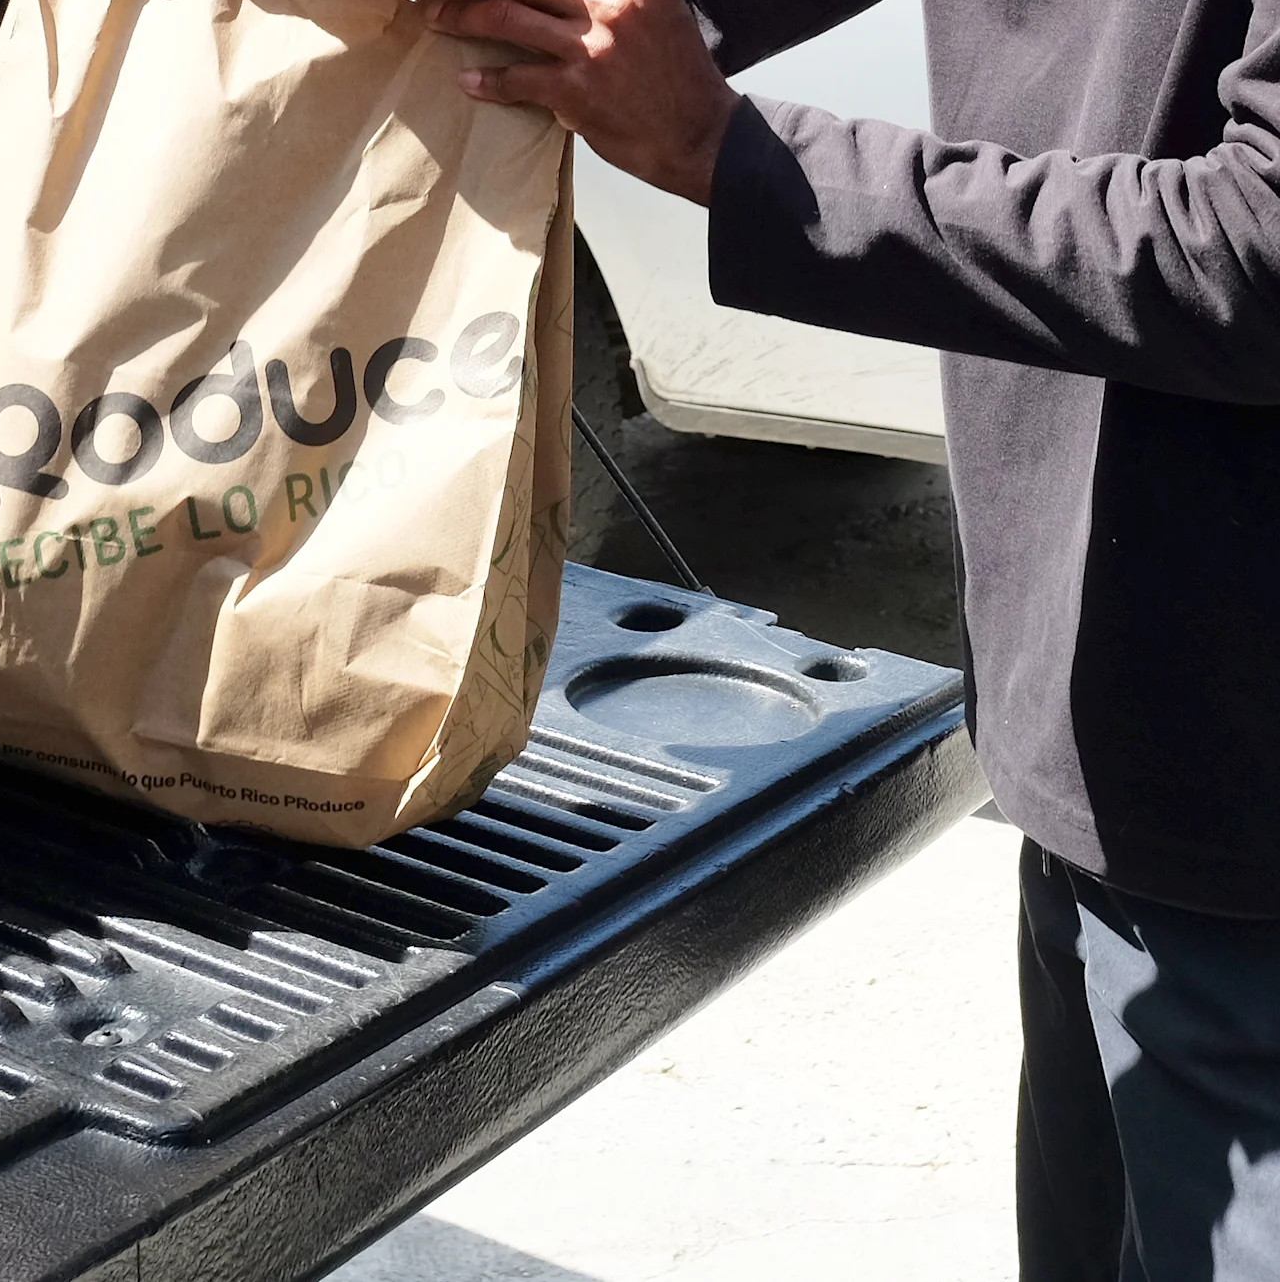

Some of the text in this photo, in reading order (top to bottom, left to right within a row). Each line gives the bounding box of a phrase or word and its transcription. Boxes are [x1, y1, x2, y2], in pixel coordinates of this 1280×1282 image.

[186, 484, 259, 541] LO
[121, 769, 138, 787] lo
[140, 773, 176, 793] que
[179, 771, 237, 800] Puerto
[240, 787, 280, 807] Rico
[283, 794, 366, 814] PRoduce
